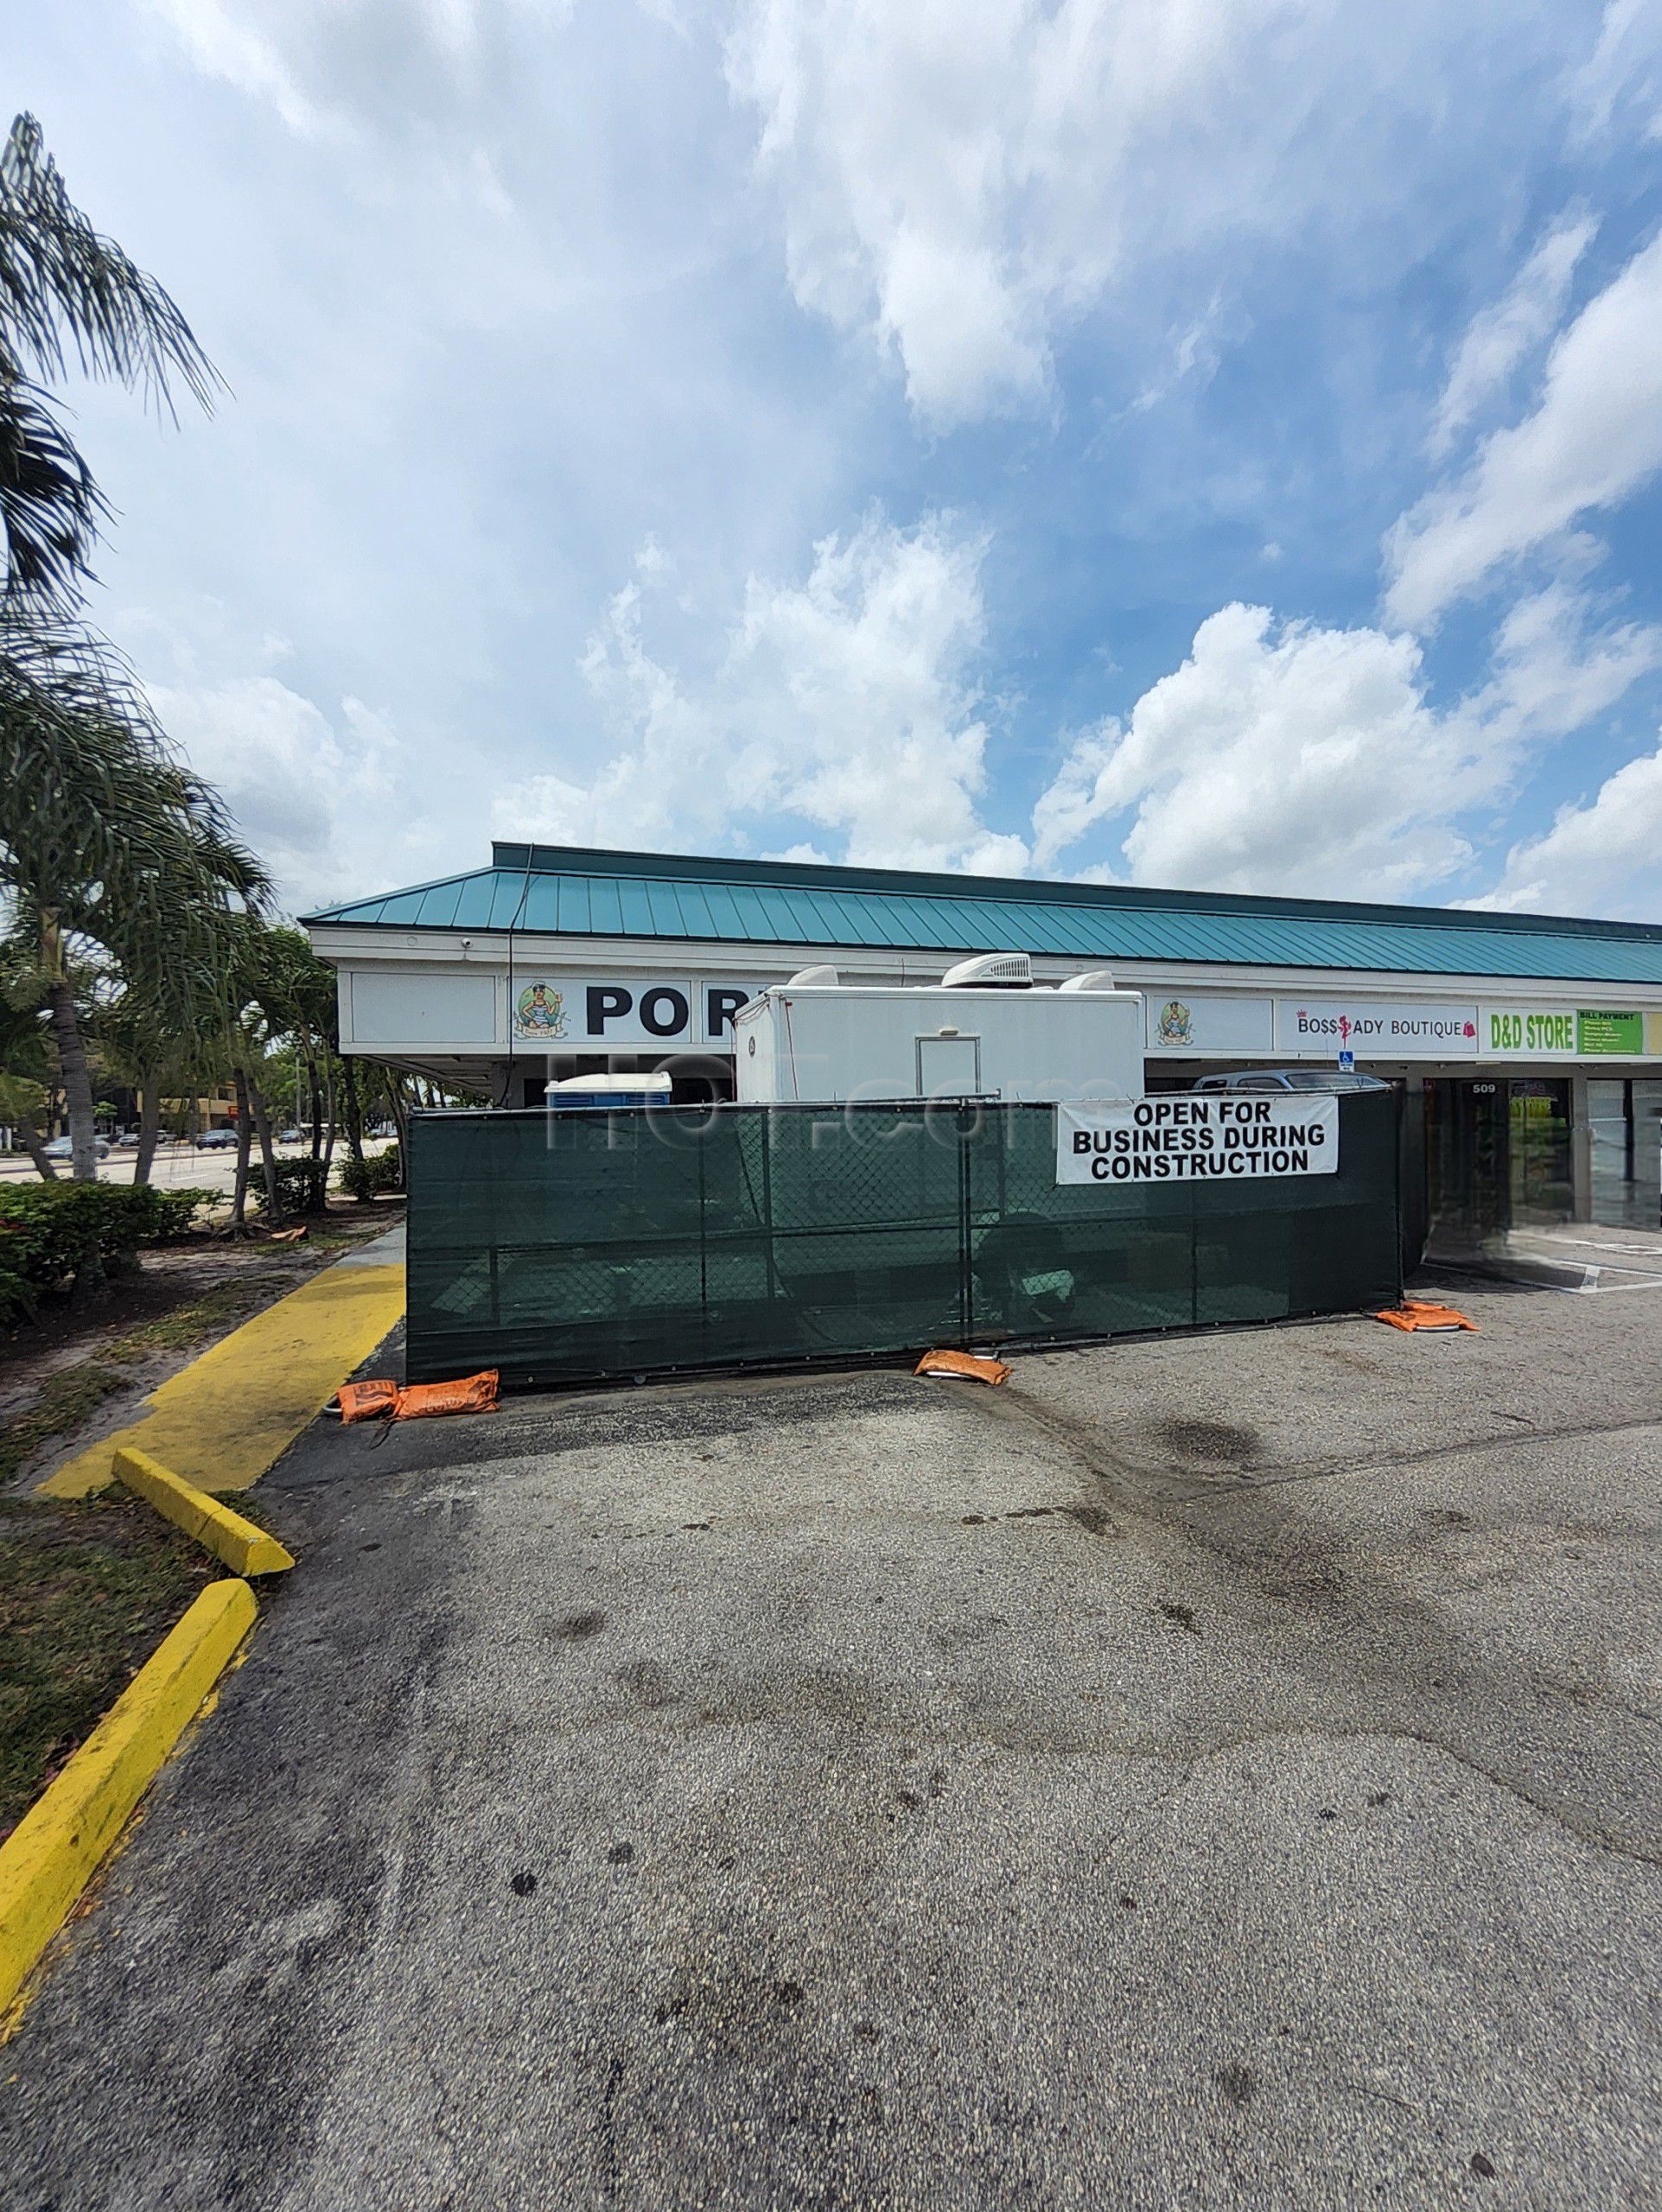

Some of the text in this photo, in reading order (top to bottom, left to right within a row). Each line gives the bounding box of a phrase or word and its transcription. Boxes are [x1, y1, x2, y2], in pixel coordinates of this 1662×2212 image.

[586, 986, 766, 1036] POR
[1599, 1012, 1634, 1020] PAYMENT
[1391, 1020, 1461, 1039] BOUTIQUE
[1491, 1014, 1573, 1049] D&D STORE
[1473, 1084, 1496, 1093] 509
[1134, 1101, 1271, 1126] OPEN FOR
[1073, 1124, 1325, 1154] BUSINESS DURING
[1091, 1150, 1309, 1180] CONSTRUCTION
